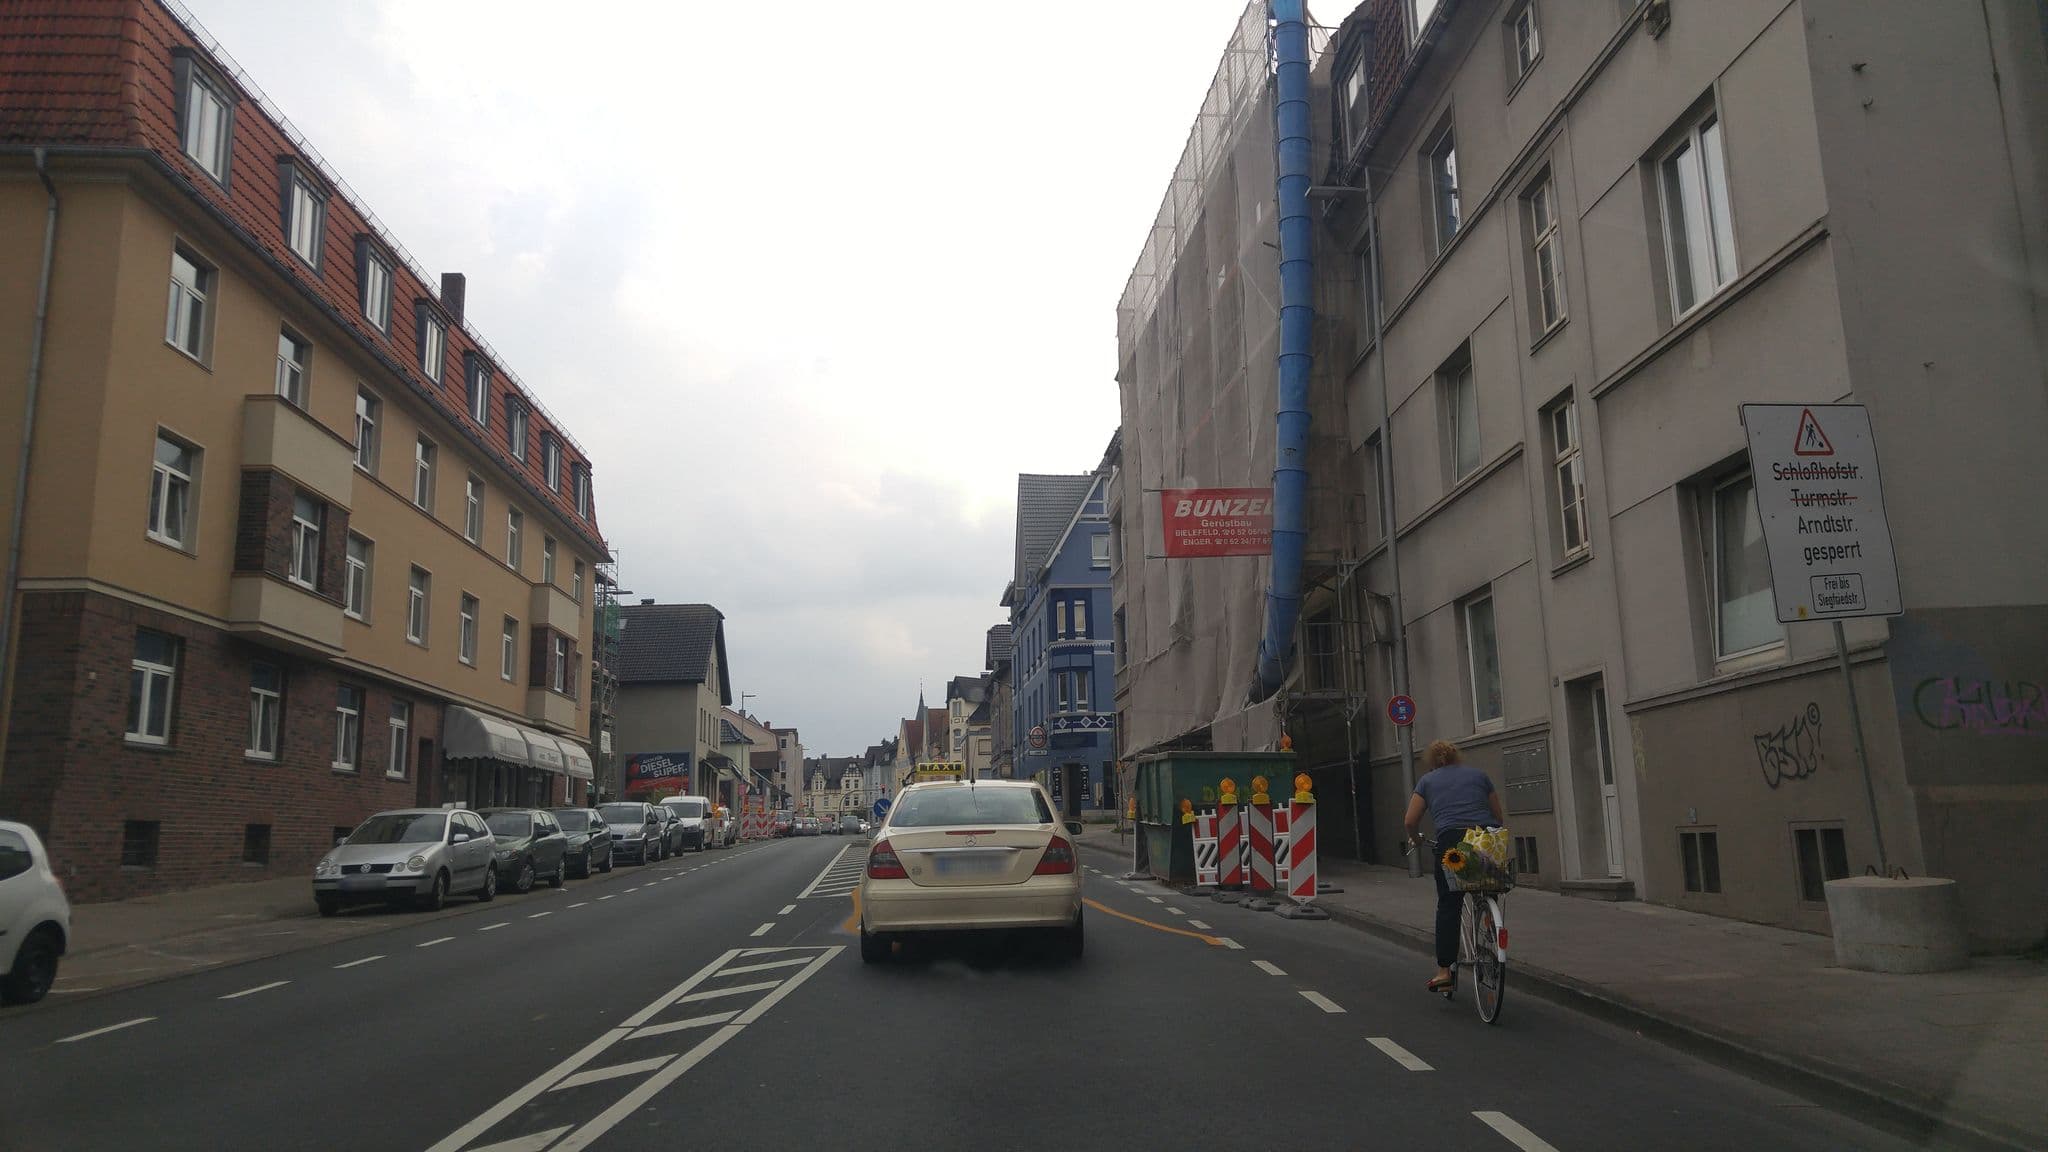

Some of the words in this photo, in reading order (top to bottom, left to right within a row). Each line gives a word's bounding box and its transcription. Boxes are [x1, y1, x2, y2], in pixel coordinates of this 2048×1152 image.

[1772, 462, 1864, 481] Schloßhofstr.
[1791, 489, 1853, 508] Turmstr.
[1201, 519, 1253, 528] Gerüstbau
[1798, 514, 1859, 534] Arndtstr.
[1804, 541, 1862, 566] gesperrt
[1824, 577, 1838, 591] Frei
[1838, 576, 1850, 590] bis
[640, 759, 674, 773] DIESEL
[926, 762, 957, 771] TAXI
